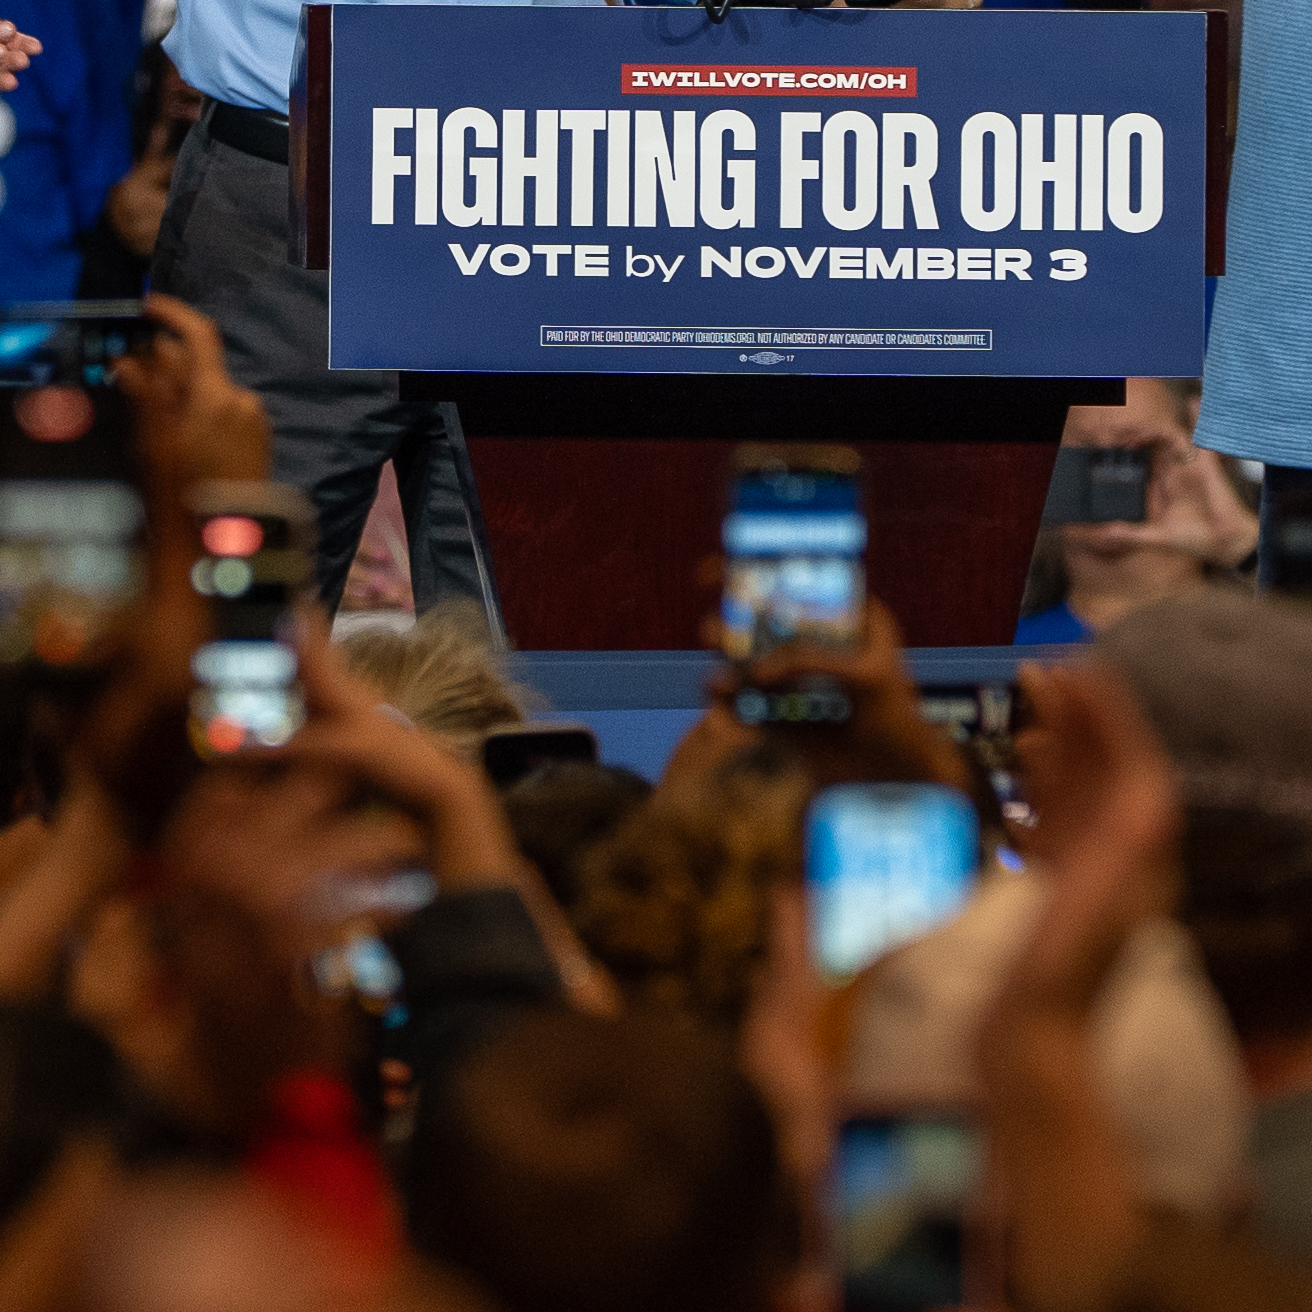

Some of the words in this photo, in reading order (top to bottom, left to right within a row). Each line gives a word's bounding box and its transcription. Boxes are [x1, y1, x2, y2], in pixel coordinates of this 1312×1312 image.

[631, 71, 907, 90] IWILLVOTE.COM/OH
[371, 106, 758, 231] FIGHTING
[779, 109, 940, 231] FOR
[959, 111, 1165, 234] OHIO
[447, 243, 610, 277] VOTE
[625, 245, 686, 283] by
[700, 245, 1033, 281] NOVEMBER
[1049, 248, 1088, 282] 3
[546, 331, 563, 342] PAID
[565, 331, 579, 342] FOR
[580, 331, 590, 342] BY
[591, 331, 604, 342] THE
[605, 331, 624, 343] OHIO
[624, 331, 671, 343] DEMOCRATIC
[671, 331, 694, 343] PARTY
[757, 332, 772, 344] NOT
[773, 333, 817, 344] AUTHORIZED
[818, 333, 828, 344] BY
[828, 333, 844, 344] ANY
[845, 333, 884, 345] CANDIDATE
[885, 334, 897, 345] OR
